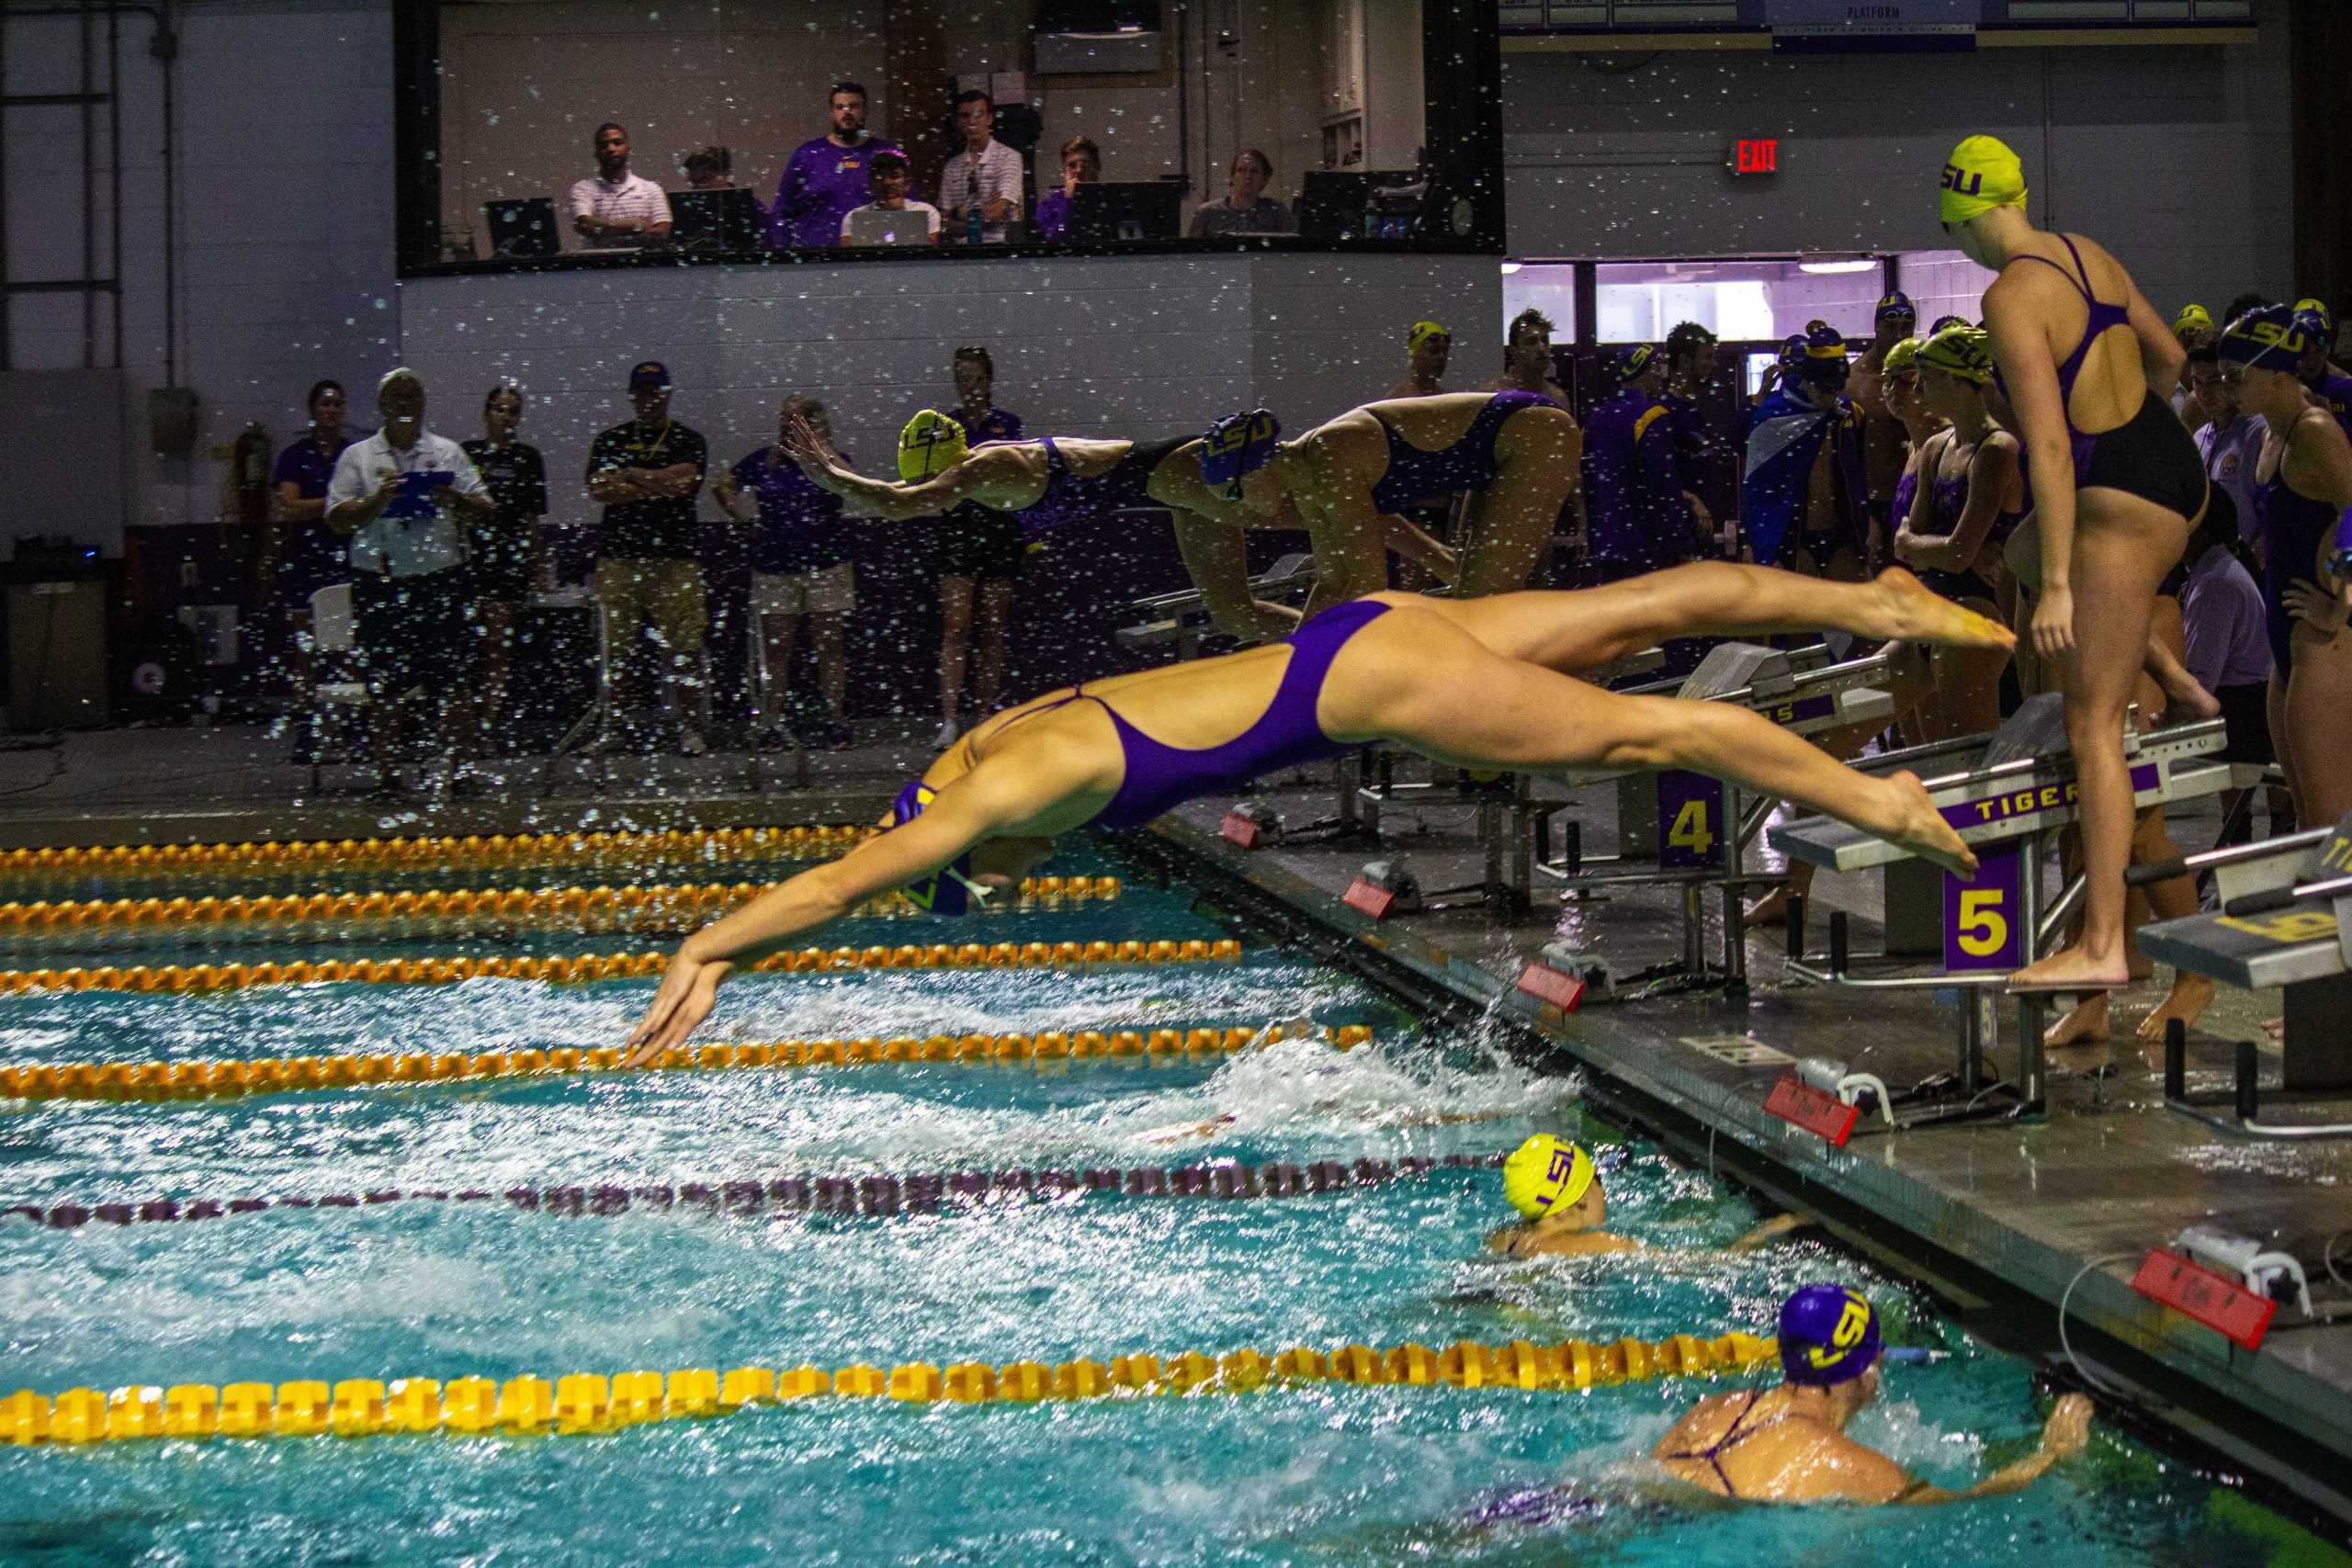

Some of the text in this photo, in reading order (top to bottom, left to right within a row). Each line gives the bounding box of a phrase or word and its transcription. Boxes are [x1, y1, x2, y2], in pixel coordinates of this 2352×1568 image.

[1847, 6, 1900, 18] PLATFORM
[1737, 140, 1779, 172] EXIT
[2227, 321, 2305, 353] LSU
[1206, 416, 1272, 457] LSU
[1668, 800, 1713, 853] 4
[1958, 888, 2007, 956] 5
[1808, 1289, 1871, 1370] LSU
